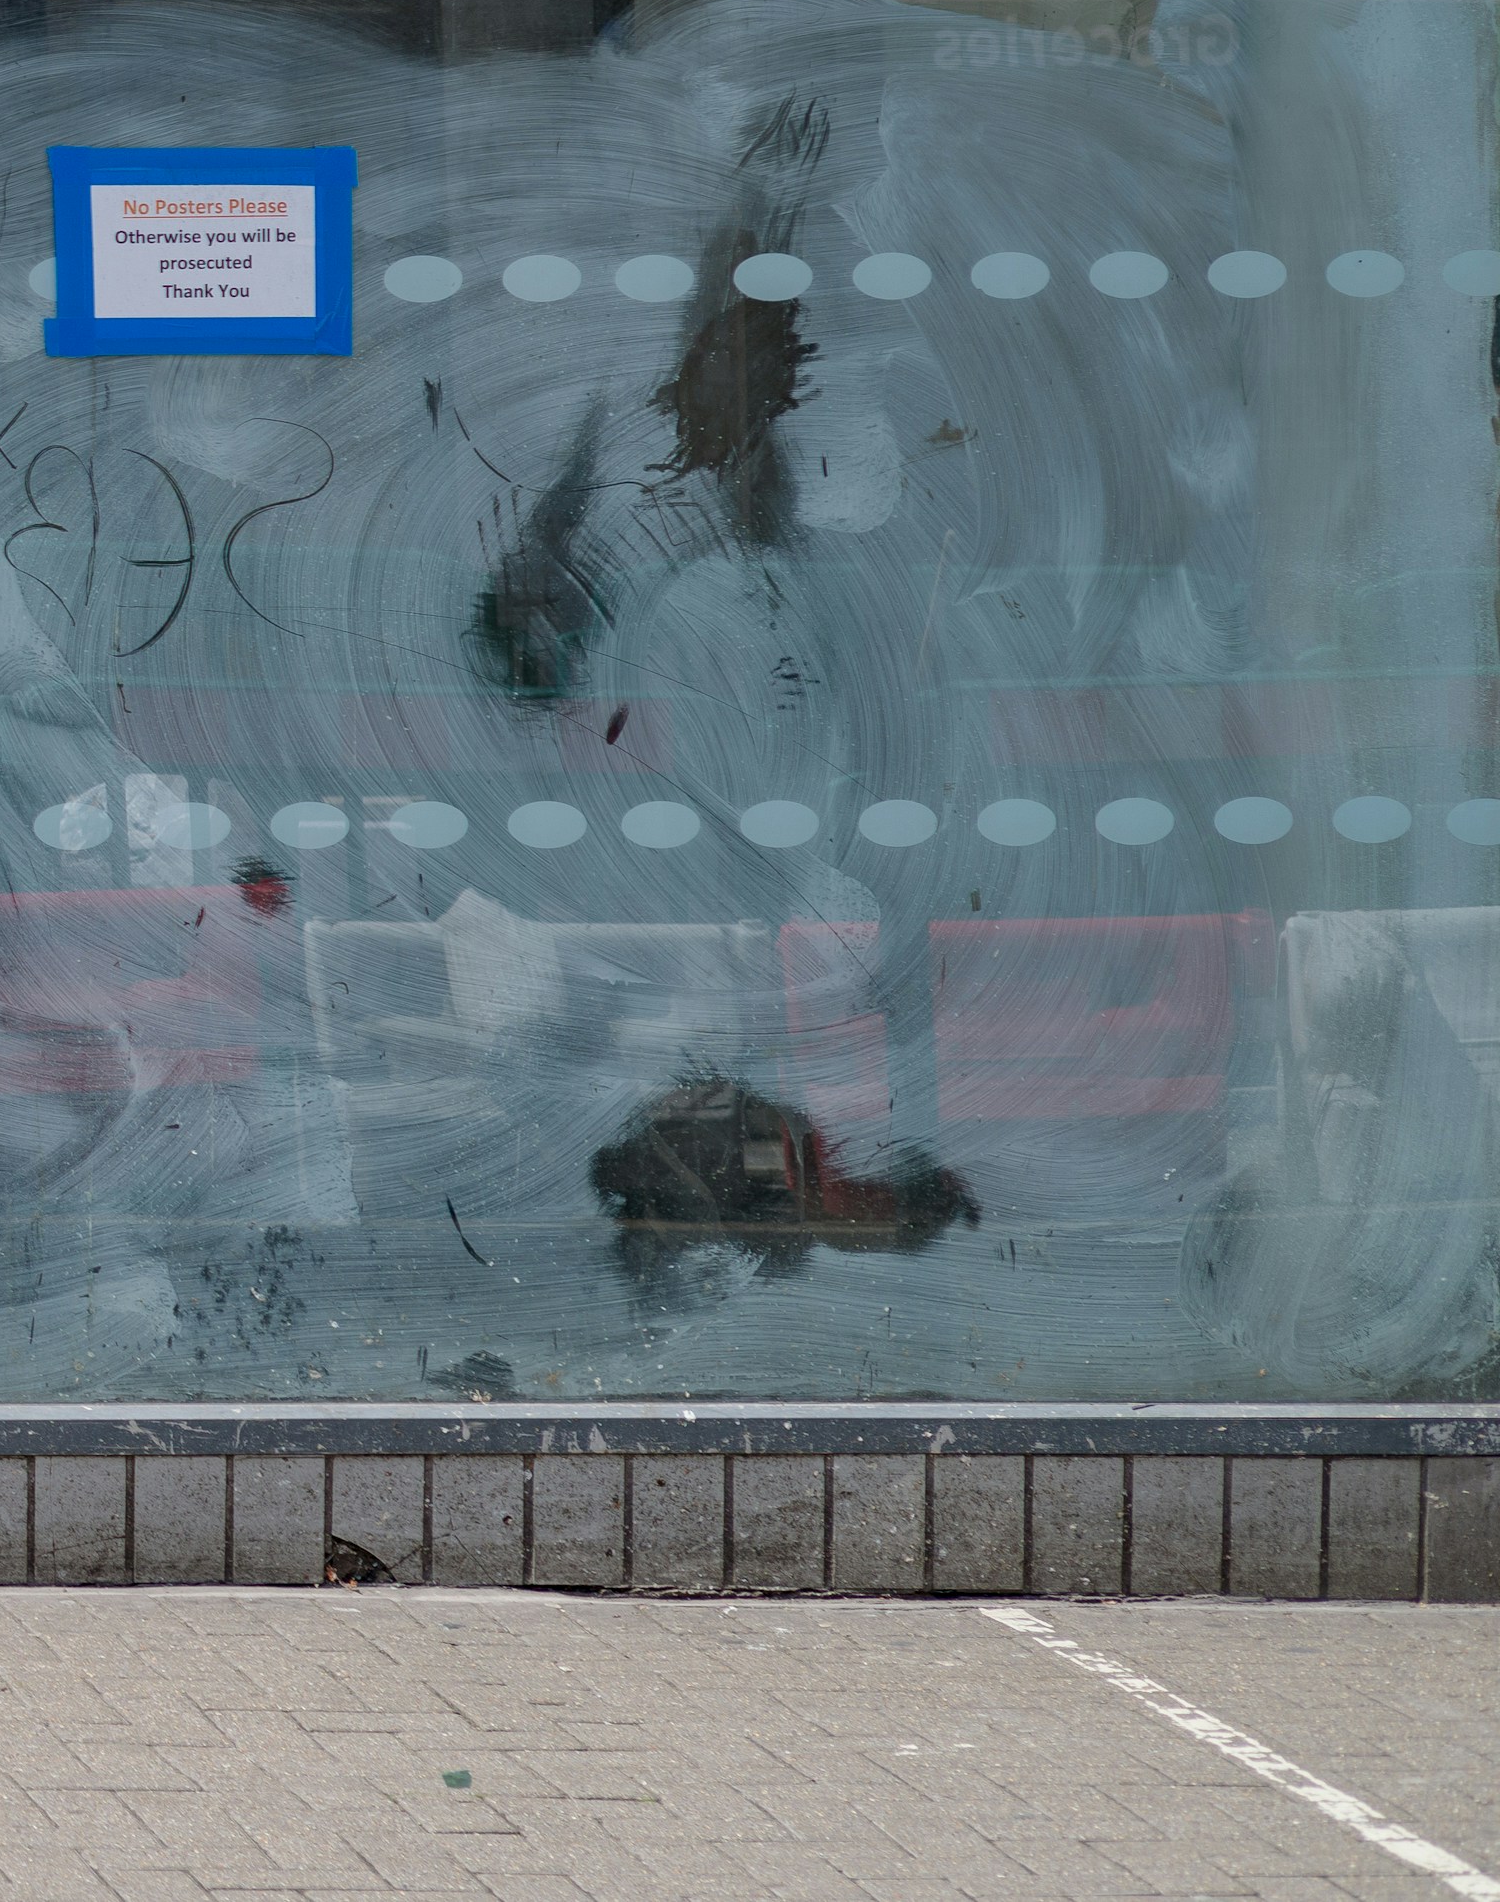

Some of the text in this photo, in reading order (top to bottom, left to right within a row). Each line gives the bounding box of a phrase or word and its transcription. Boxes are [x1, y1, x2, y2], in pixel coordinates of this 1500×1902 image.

[123, 198, 288, 216] No Posters Please
[115, 229, 297, 247] Otherwise you will be
[159, 255, 253, 273] prosecuted
[162, 284, 250, 299] Thank You
